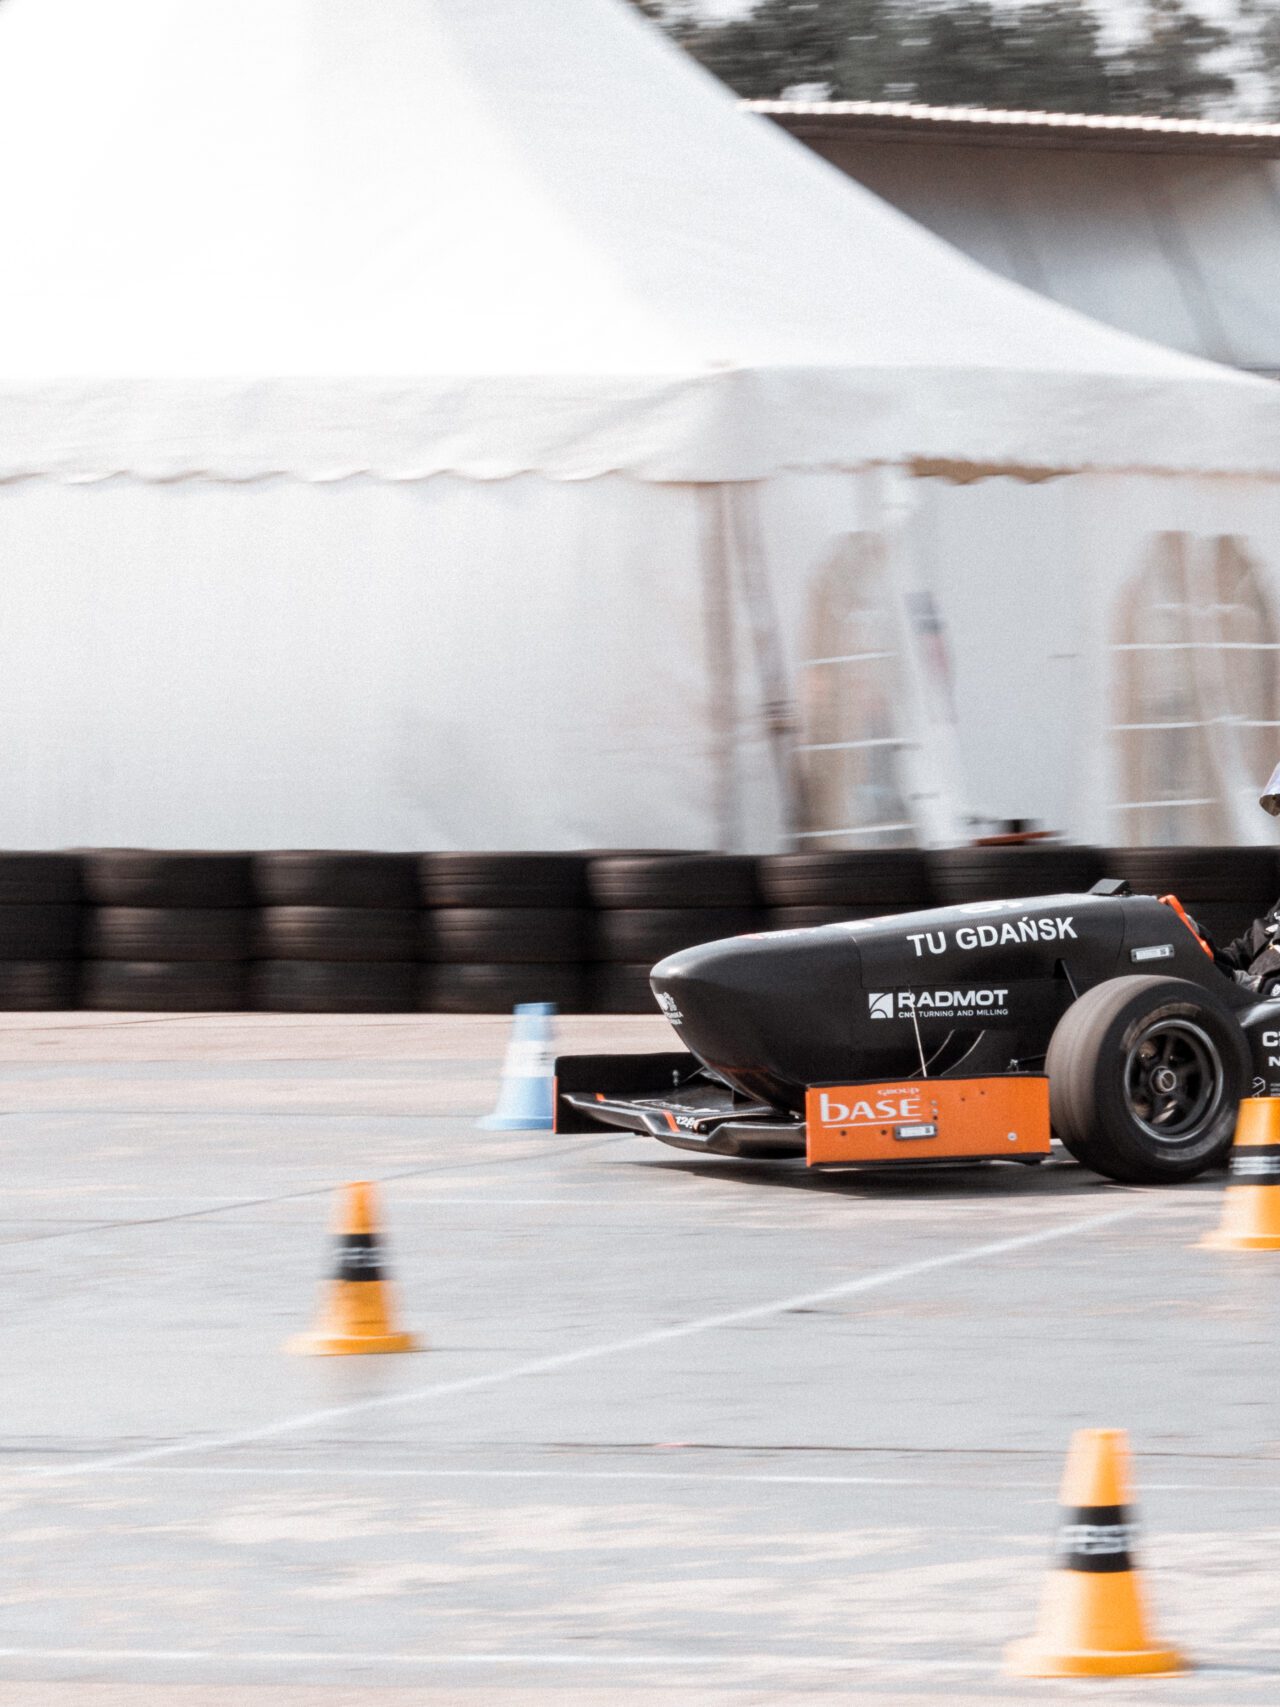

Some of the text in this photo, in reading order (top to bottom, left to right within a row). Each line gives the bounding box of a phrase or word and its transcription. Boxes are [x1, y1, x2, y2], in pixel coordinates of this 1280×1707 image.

[906, 916, 1078, 957] TU GDAŃSK
[898, 990, 1009, 1008] RADMOT
[919, 1010, 954, 1018] TURNING
[976, 1008, 1009, 1016] MILLING
